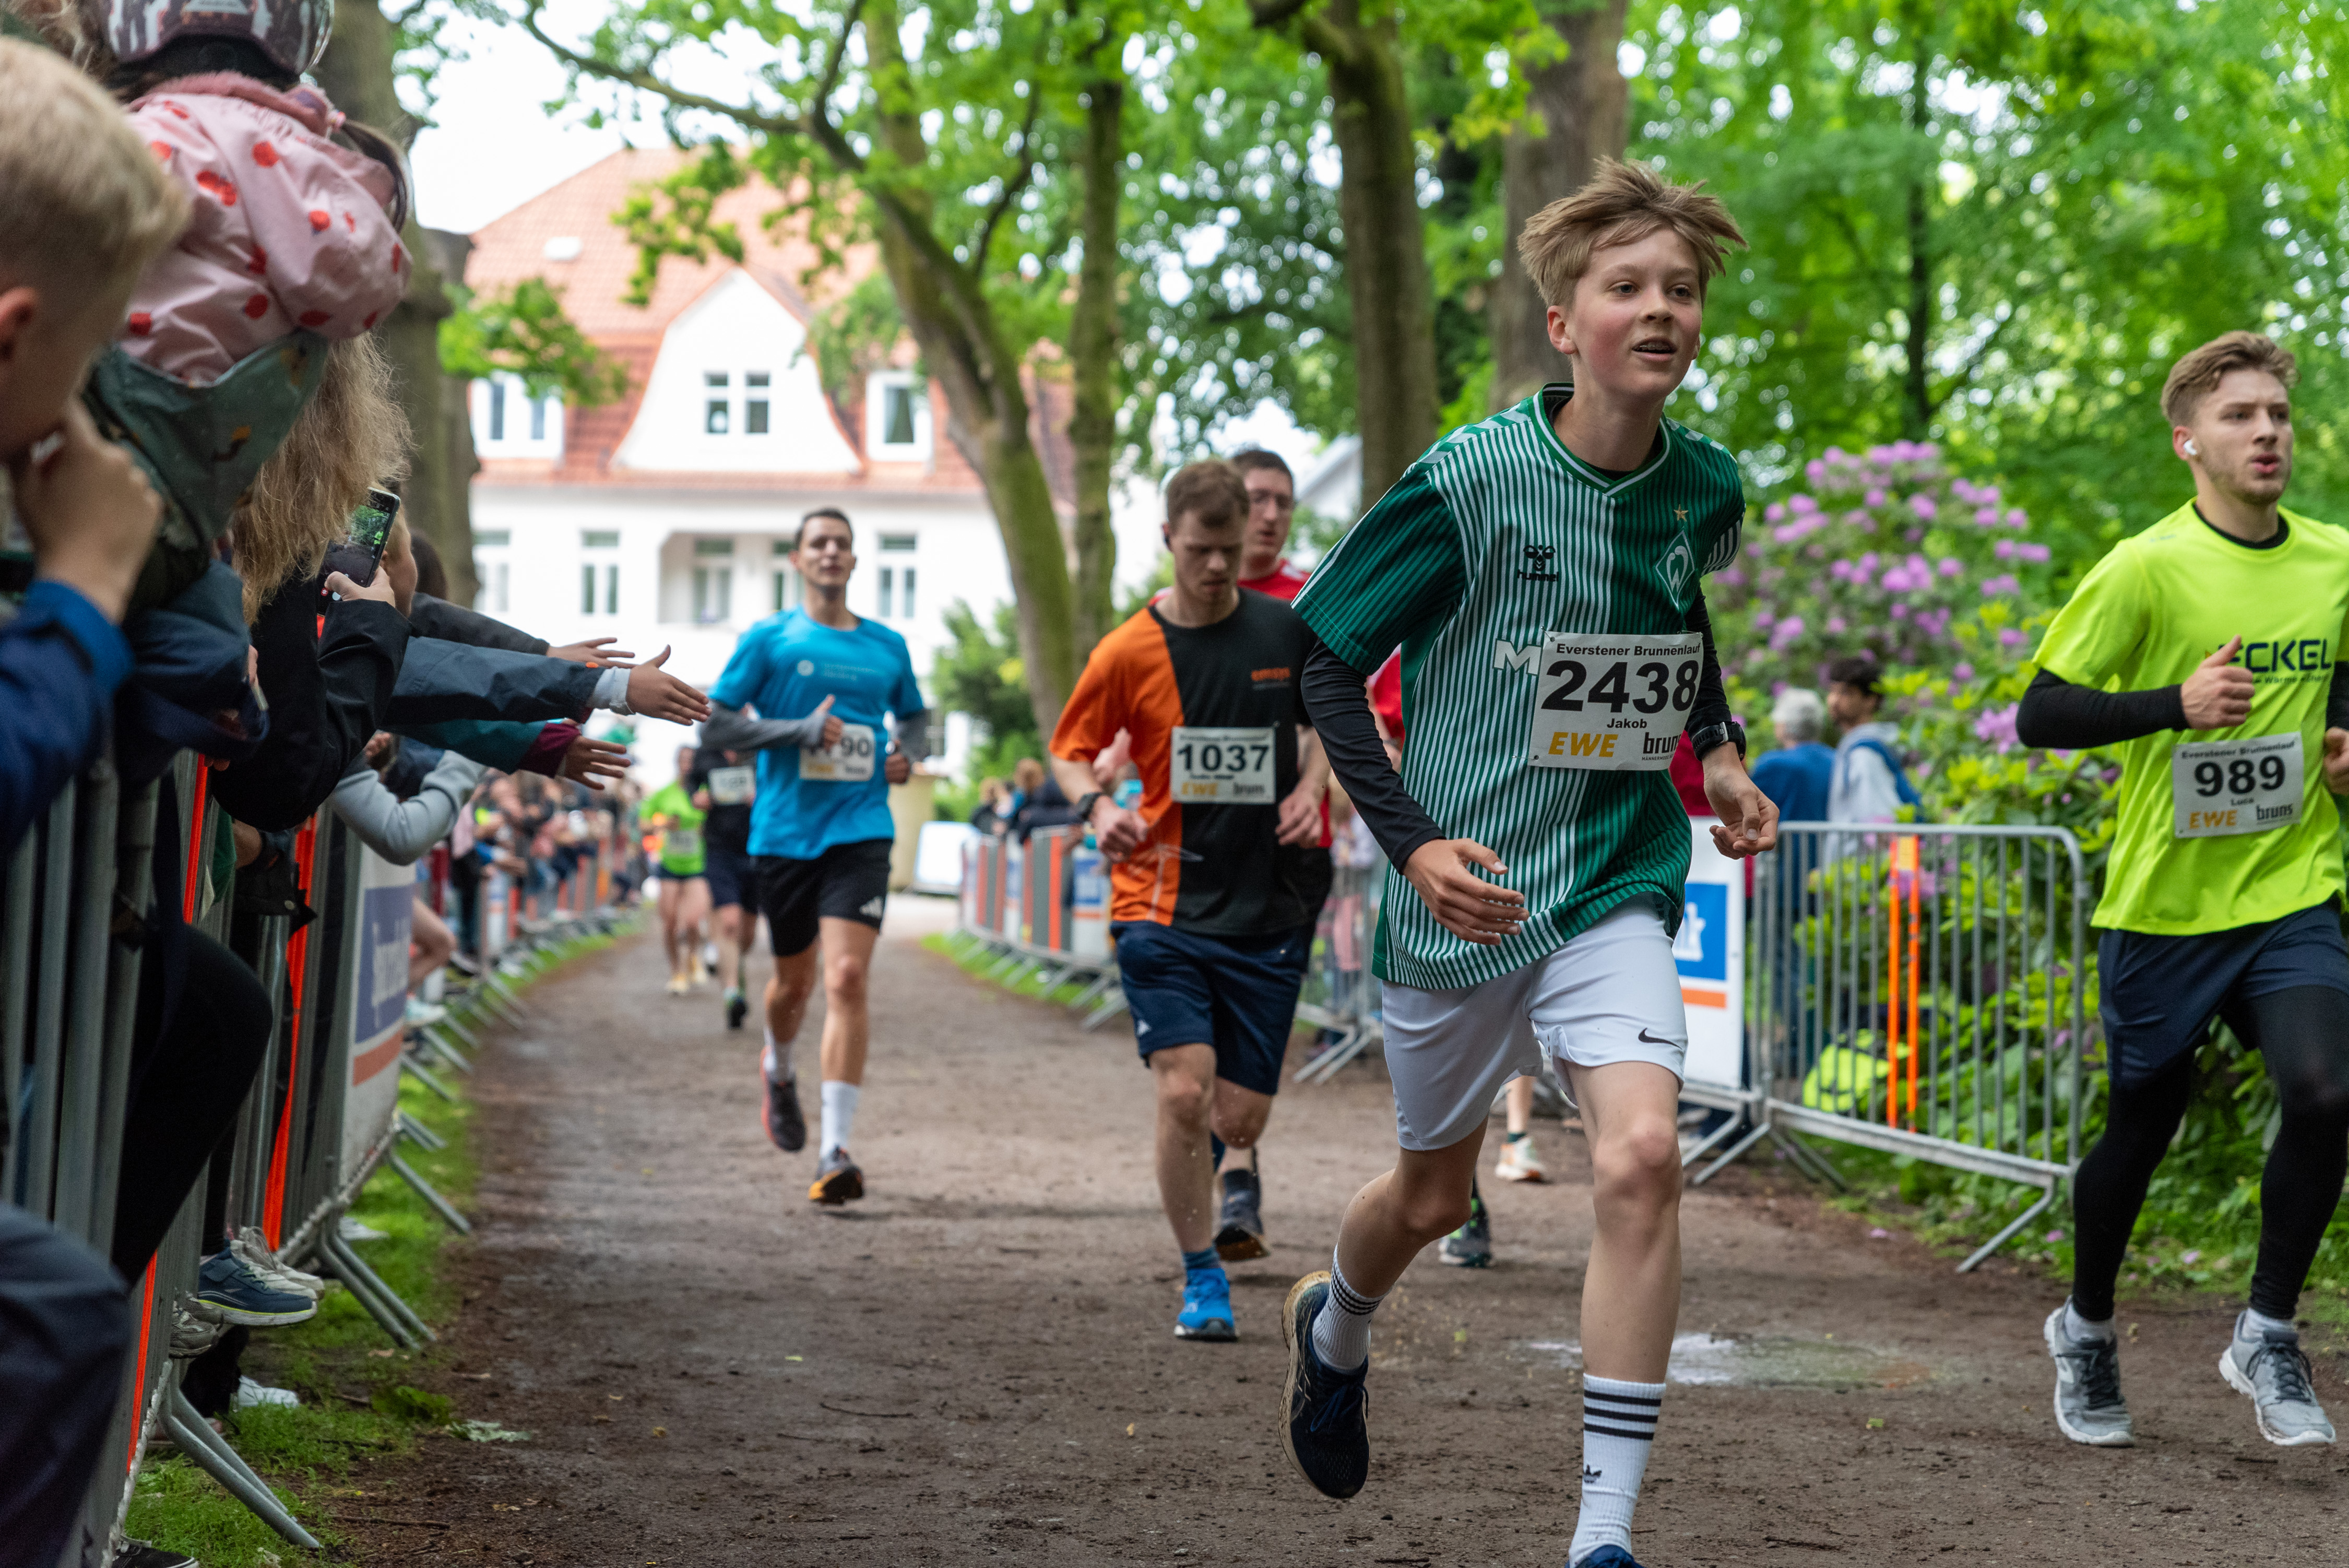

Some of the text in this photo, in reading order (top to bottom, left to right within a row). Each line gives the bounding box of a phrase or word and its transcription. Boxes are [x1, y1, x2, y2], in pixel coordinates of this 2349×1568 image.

[1517, 569, 1559, 581] hummel
[1556, 643, 1700, 656] Everstener Brunnenlauf
[1540, 660, 1699, 714] 2438
[1607, 718, 1647, 729] Jakob
[1548, 732, 1618, 757] EWE
[1177, 743, 1270, 772] 1037
[2194, 755, 2286, 797] 989
[2189, 810, 2237, 829] EWE
[2256, 803, 2293, 820] bruns
